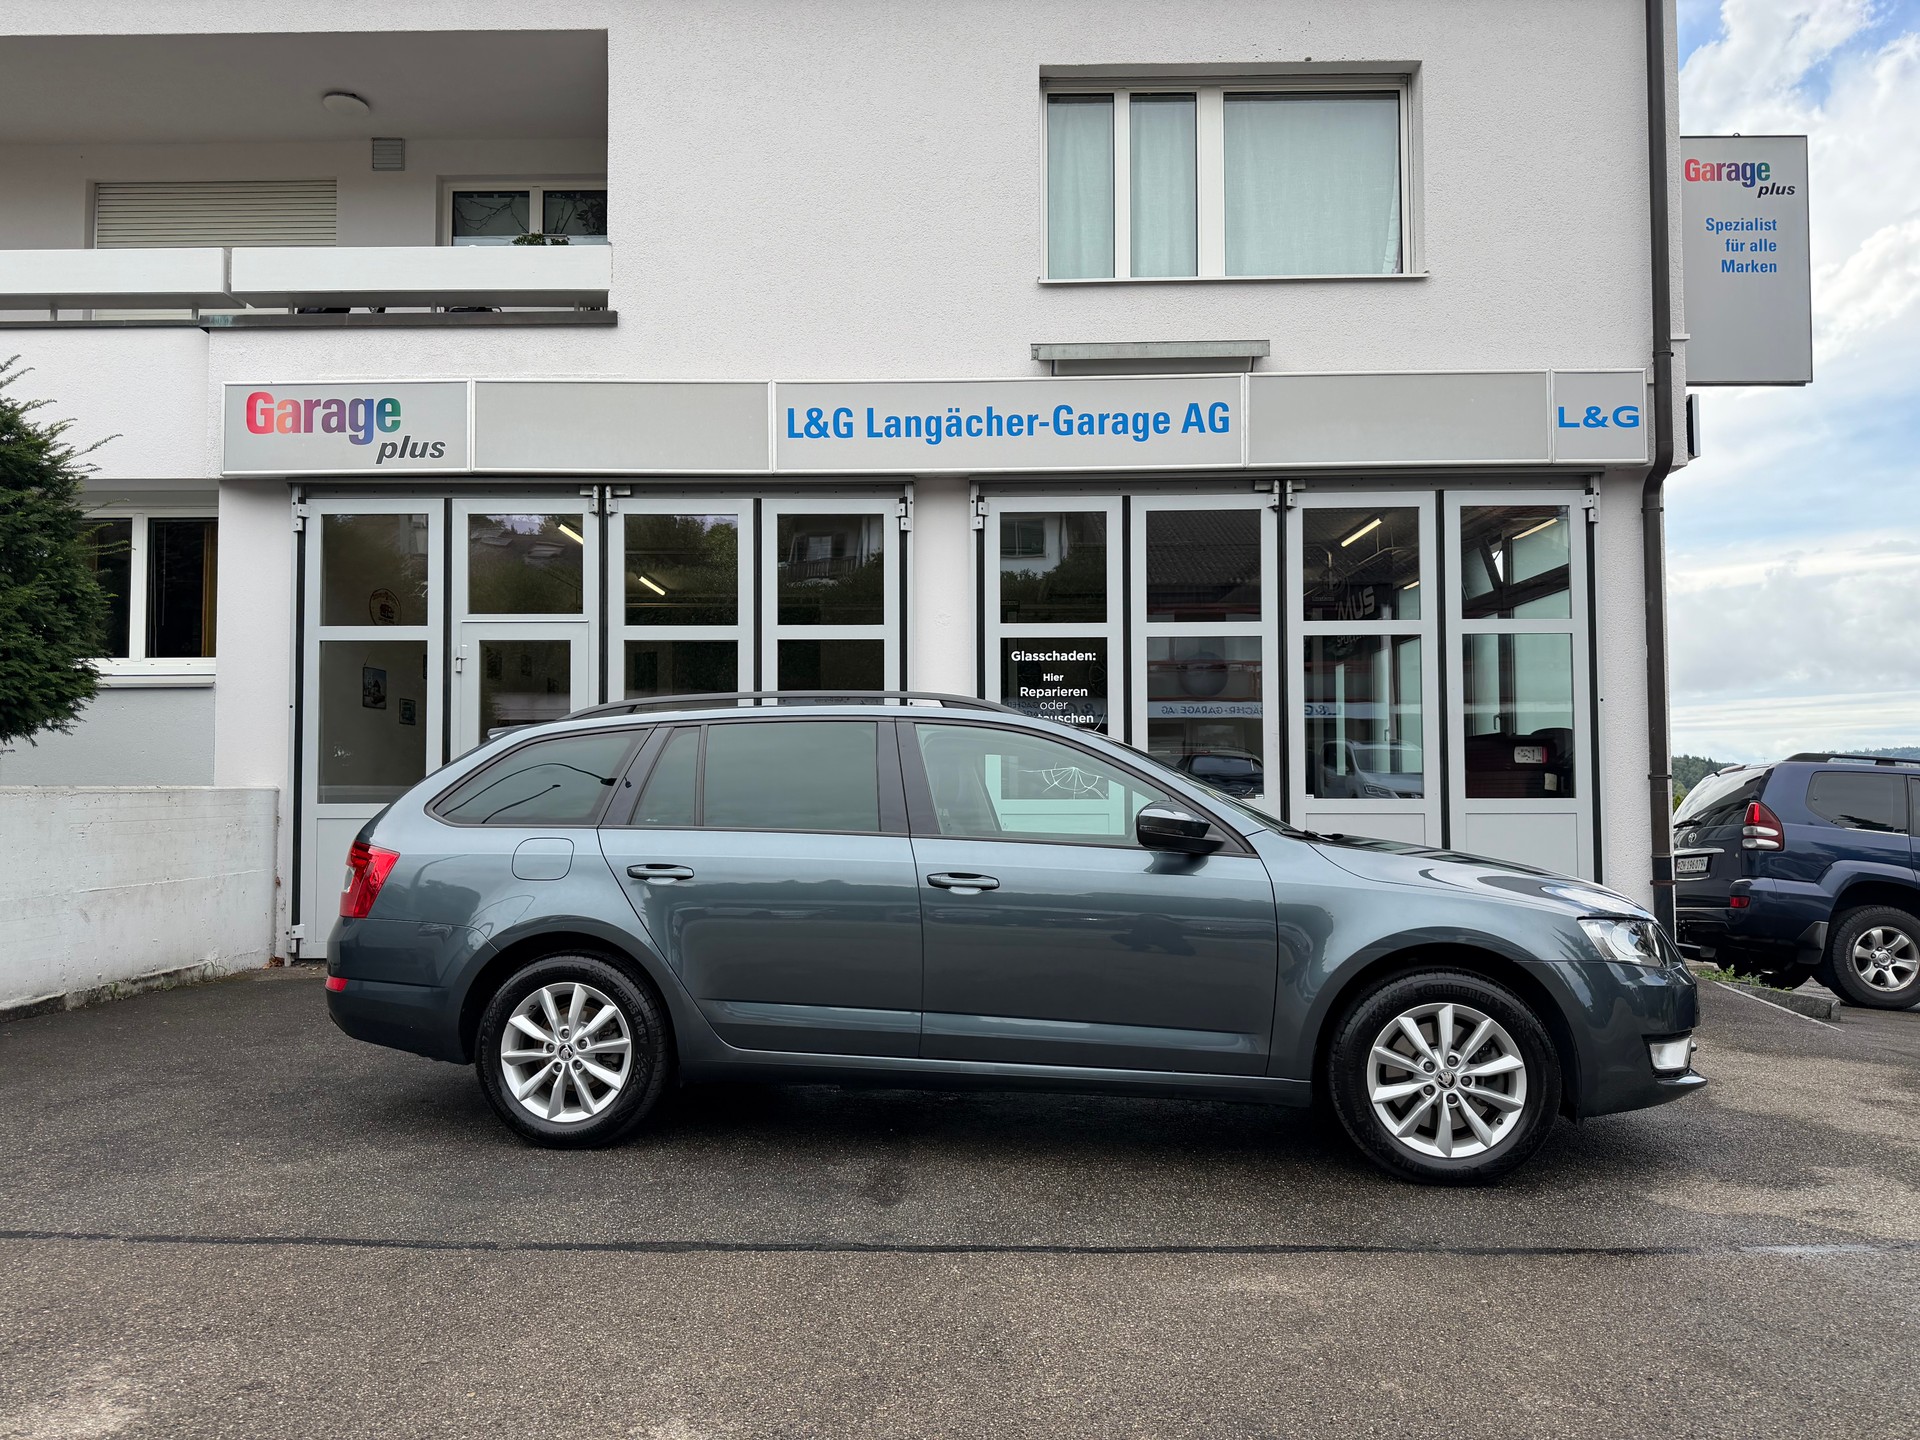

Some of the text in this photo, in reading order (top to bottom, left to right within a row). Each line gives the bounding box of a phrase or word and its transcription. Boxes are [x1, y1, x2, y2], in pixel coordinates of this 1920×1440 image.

[1684, 158, 1770, 188] Garage
[1757, 183, 1796, 198] plus
[1705, 217, 1778, 234] Spezialist
[1725, 238, 1777, 252] für alle
[1721, 259, 1777, 273] Marken
[246, 391, 401, 445] Garage
[786, 402, 1231, 445] L&G Langächer-Garage AG
[1557, 405, 1640, 428] L&G
[375, 435, 447, 465] plus
[1011, 650, 1097, 661] Glasschaden:
[1043, 673, 1064, 681] Hier
[1020, 686, 1089, 698] Reparieren
[1040, 700, 1069, 710] oder
